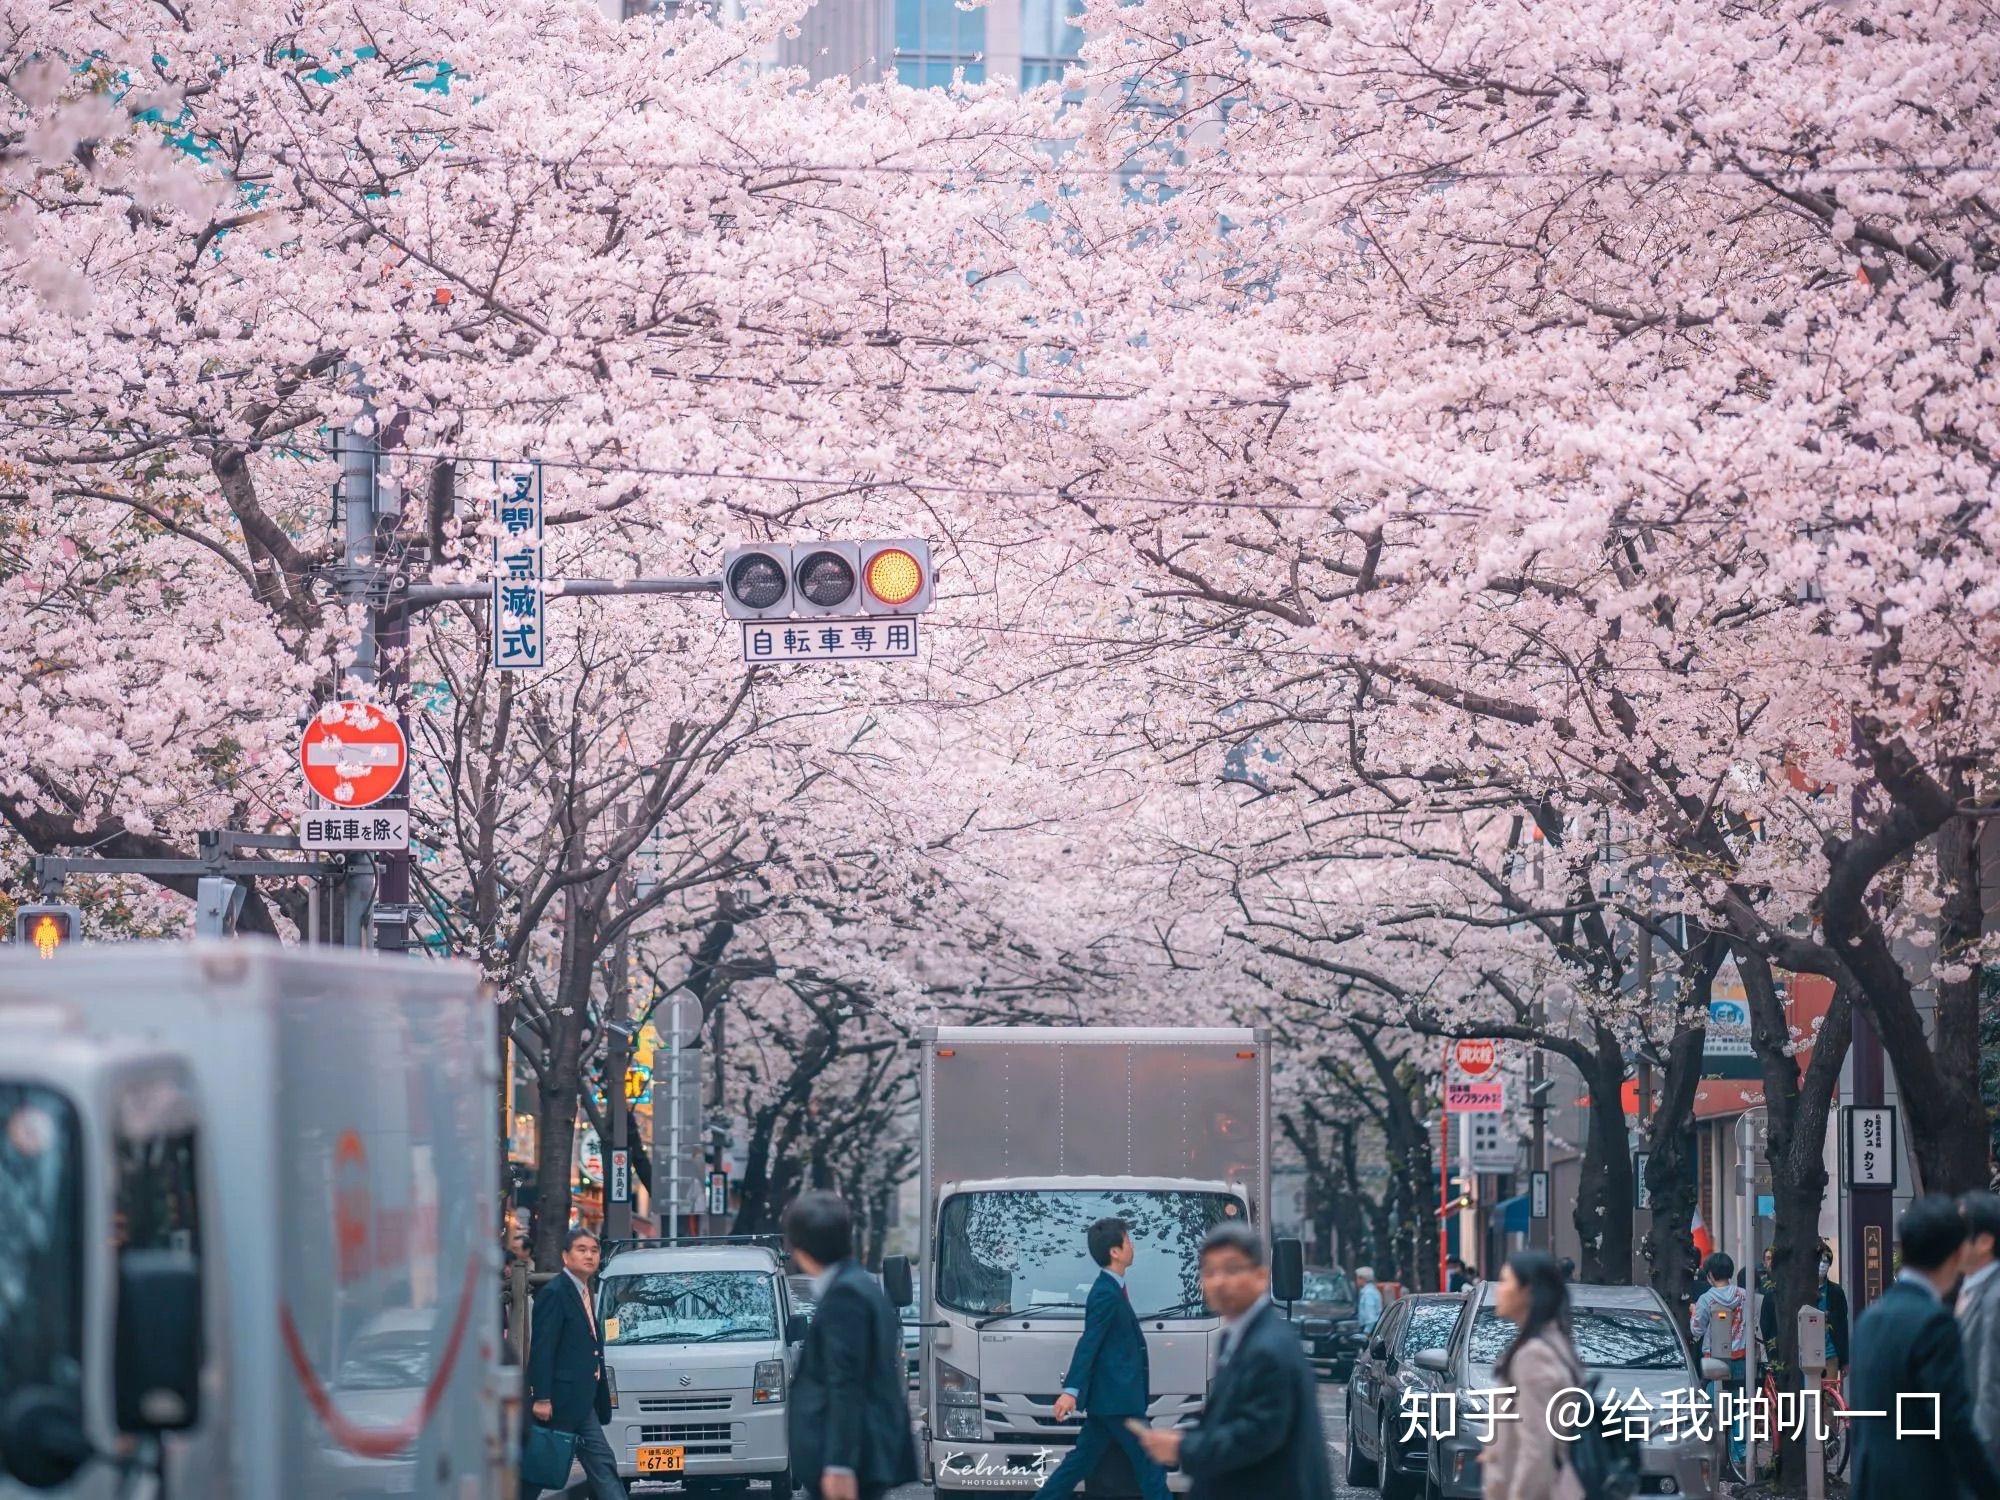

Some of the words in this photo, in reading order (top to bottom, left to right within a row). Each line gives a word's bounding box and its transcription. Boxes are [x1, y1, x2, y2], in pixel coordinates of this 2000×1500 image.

[754, 625, 909, 655] 自転車専用
[307, 819, 402, 841] 自転車を除く
[1867, 1233, 1879, 1307] 八重洲一丁
[647, 1456, 680, 1469] 67-81
